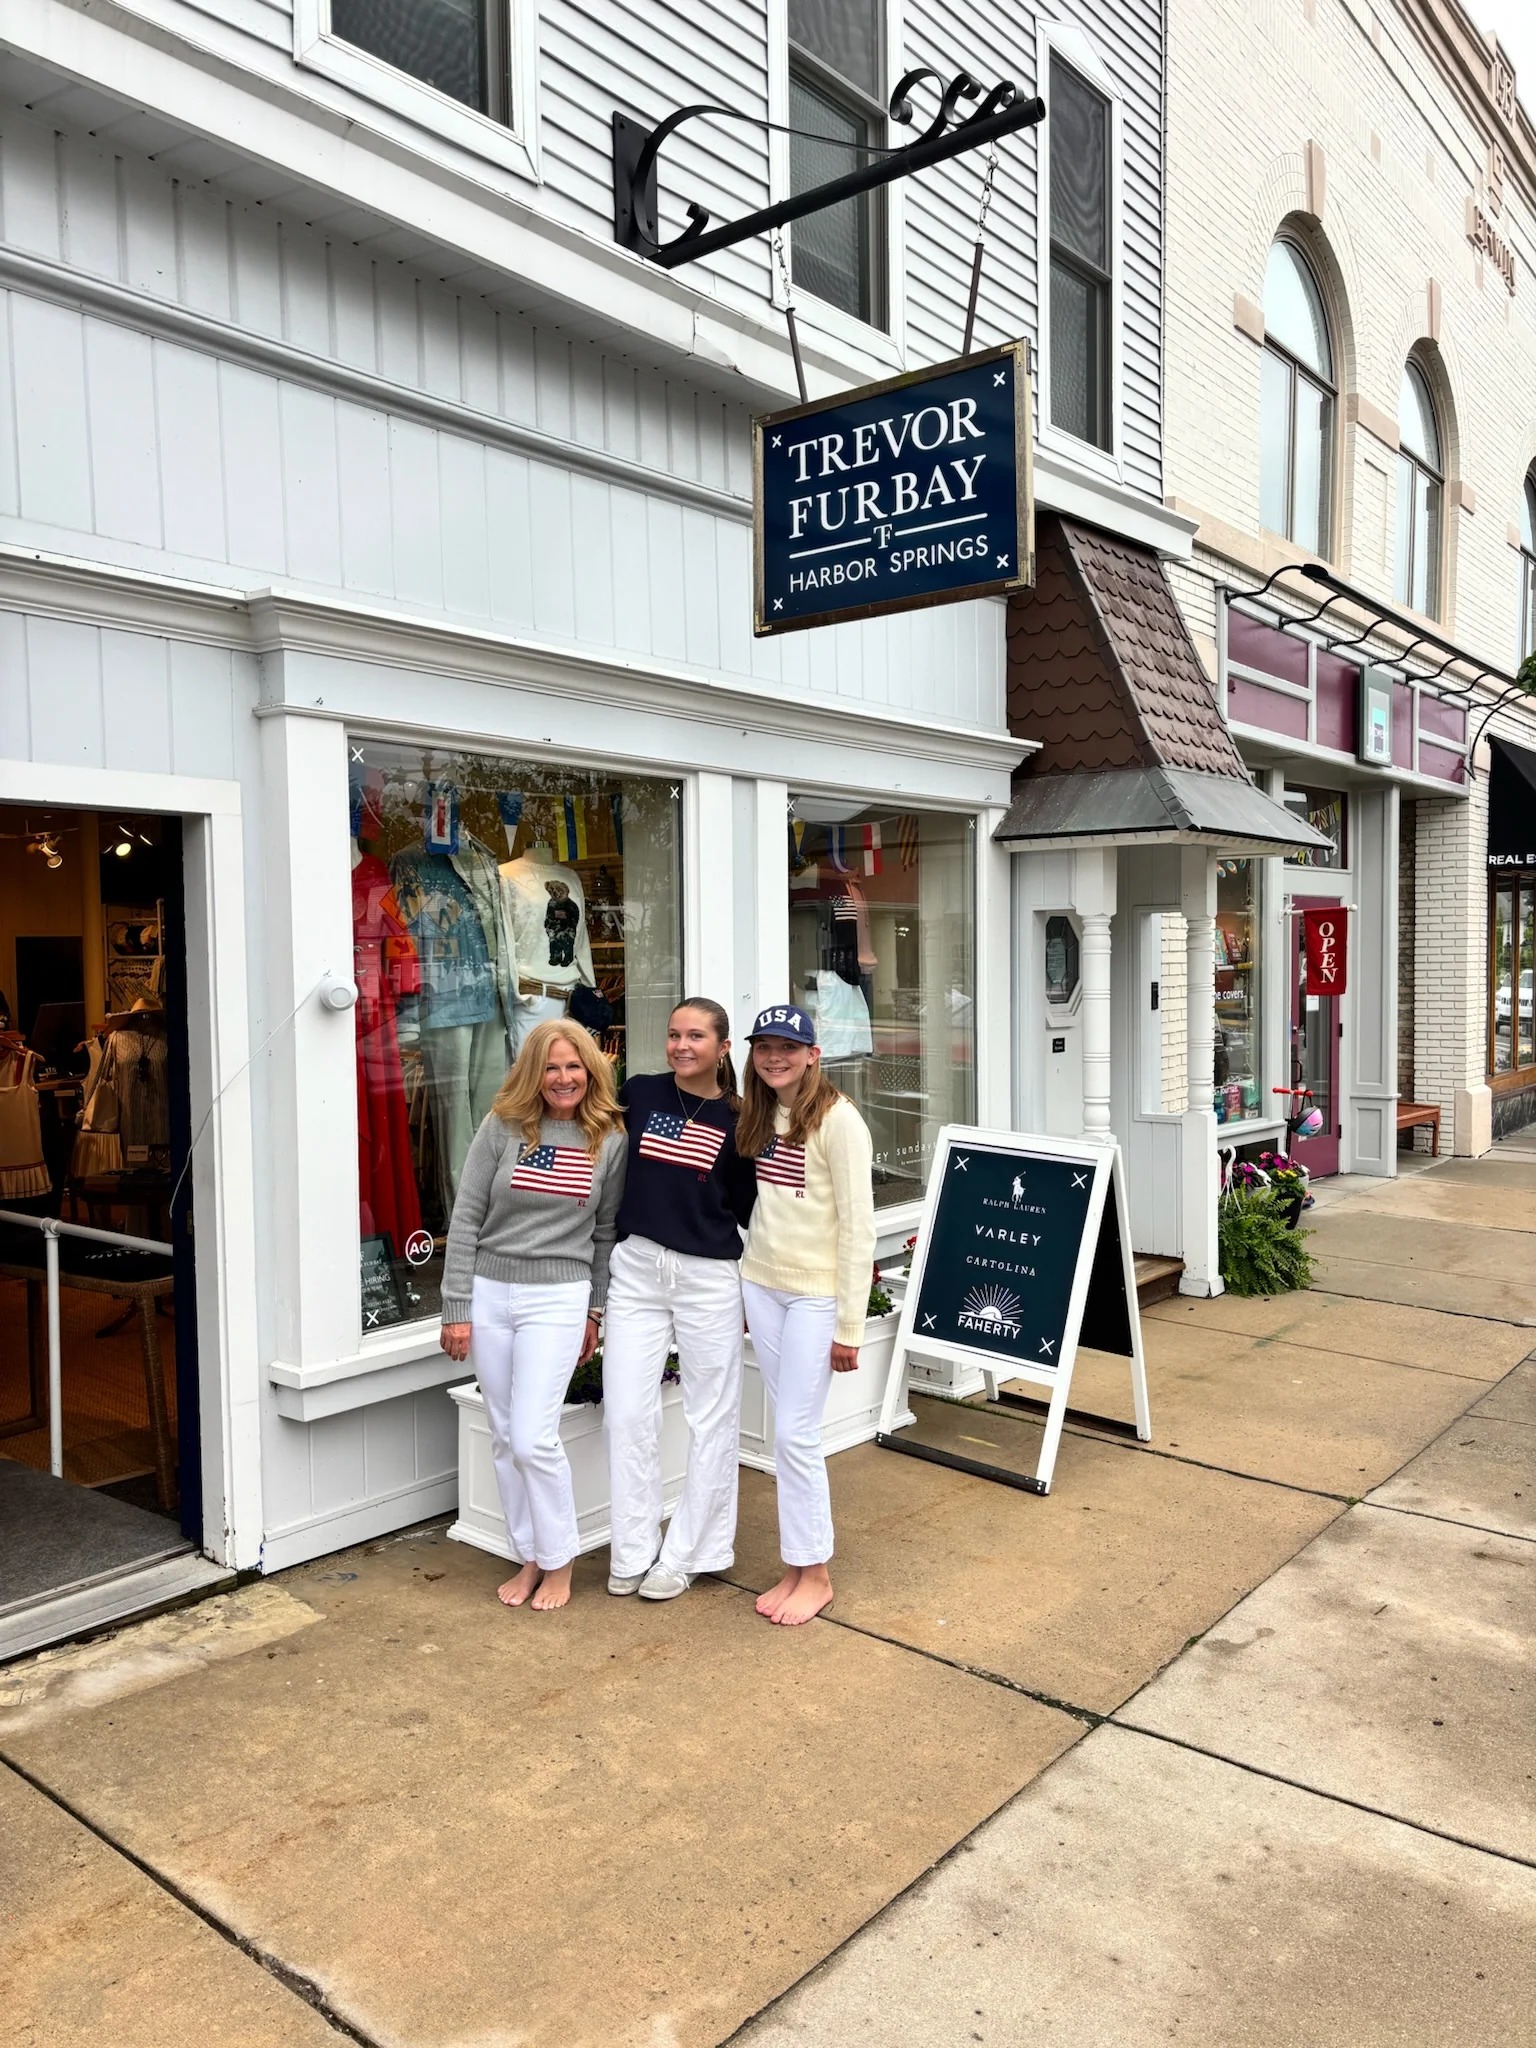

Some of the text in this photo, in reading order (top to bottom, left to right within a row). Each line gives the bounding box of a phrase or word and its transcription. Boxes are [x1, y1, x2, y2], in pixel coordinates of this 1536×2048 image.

[788, 397, 986, 483] TREVOR
[788, 454, 987, 540] FURBAY
[789, 534, 989, 593] HARBOR SPRINGS
[1489, 853, 1536, 865] REAL E
[1319, 922, 1338, 983] OPEN
[759, 1009, 802, 1031] USA
[795, 1190, 805, 1199] RL
[982, 1197, 1047, 1215] RALPH LAUREN
[975, 1224, 1042, 1247] VARLEY
[409, 1240, 431, 1256] AG
[965, 1255, 1037, 1277] CARTOLINA
[364, 1273, 391, 1286] HIRING
[957, 1314, 1021, 1340] FAHERTY
